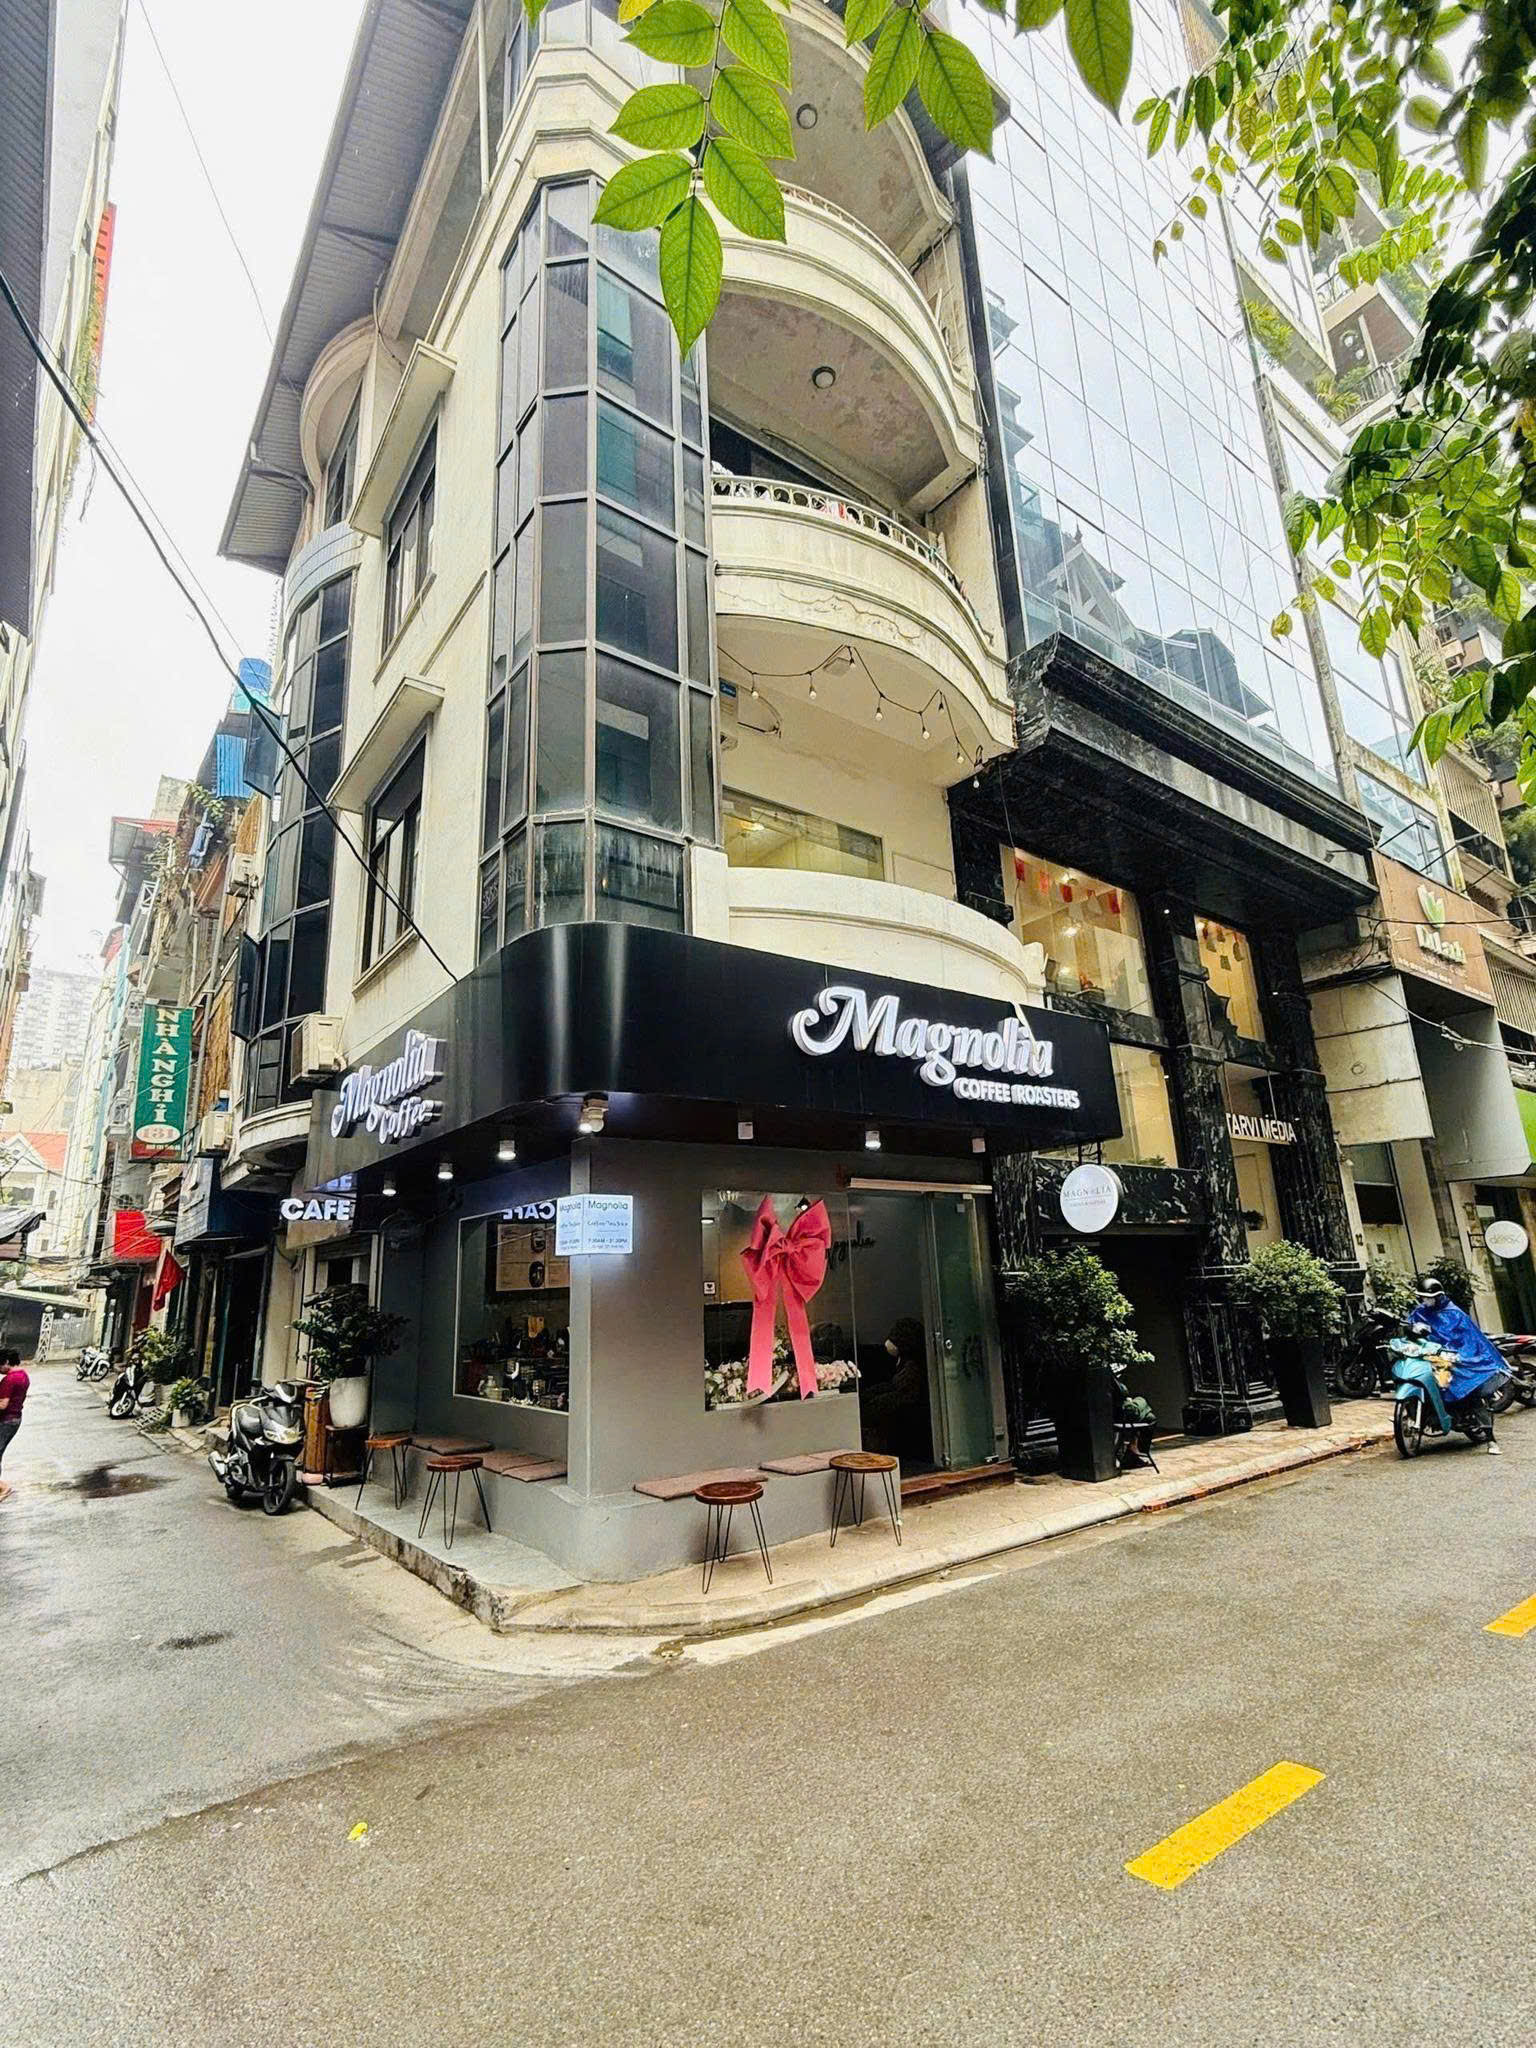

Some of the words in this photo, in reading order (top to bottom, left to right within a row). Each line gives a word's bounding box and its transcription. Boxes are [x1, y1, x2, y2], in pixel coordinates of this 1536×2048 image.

[152, 1008, 182, 1056] NHÀ
[791, 986, 1054, 1086] Magnolia
[331, 1029, 438, 1138] Magnolia
[953, 1077, 1011, 1103] COFFEE
[1011, 1084, 1080, 1109] ROASTERS
[379, 1096, 436, 1144] Coffee
[1225, 1112, 1260, 1138] TARVI
[1260, 1117, 1298, 1143] MEDIA
[280, 1198, 352, 1221] CAFE
[588, 1200, 628, 1211] Magnolia
[825, 1220, 876, 1270] agnolia
